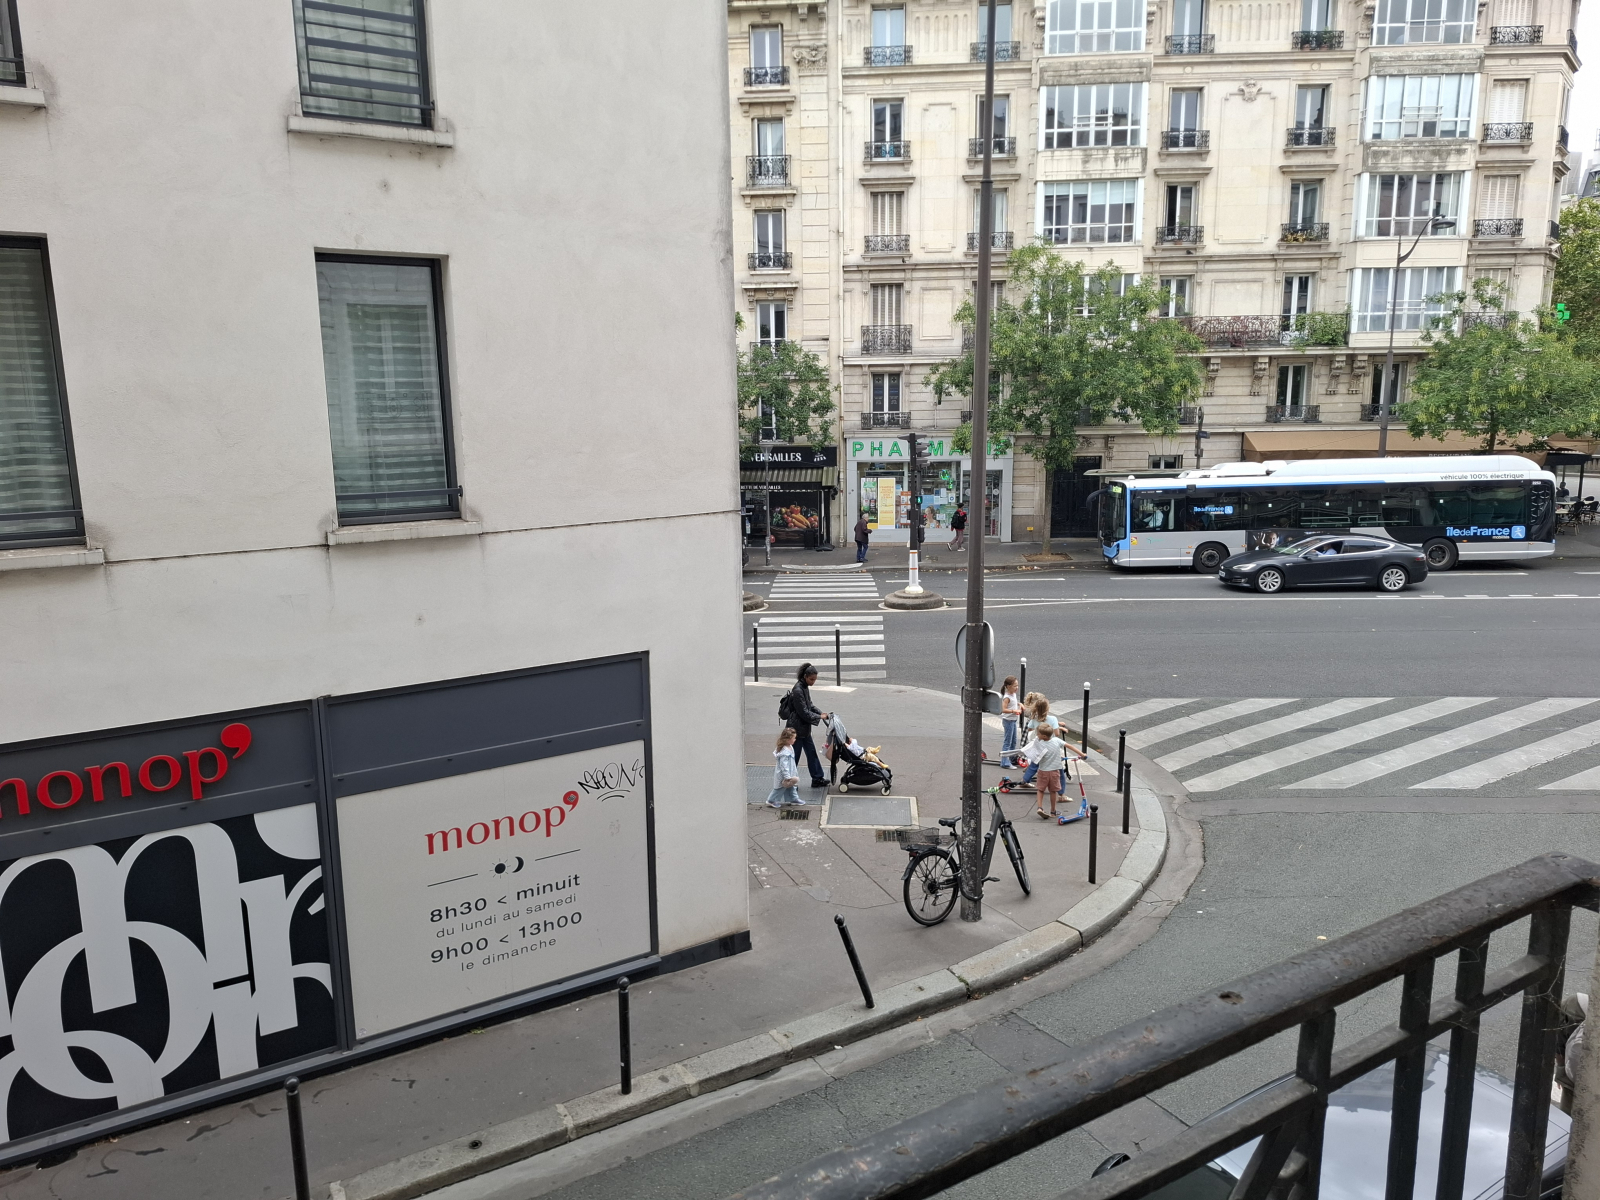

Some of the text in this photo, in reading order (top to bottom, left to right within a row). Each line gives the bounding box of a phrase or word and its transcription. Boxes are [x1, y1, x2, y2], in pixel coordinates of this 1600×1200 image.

[852, 440, 1009, 457] PHAMAIE
[1490, 472, 1525, 480] électrique
[425, 790, 580, 855] monop'
[430, 897, 487, 923] 8h30
[516, 874, 581, 901] minuit
[436, 893, 577, 938] du lundi au samedi
[430, 937, 489, 964] 9h00
[518, 911, 583, 939] 13h00
[461, 937, 557, 972] le dimanche
